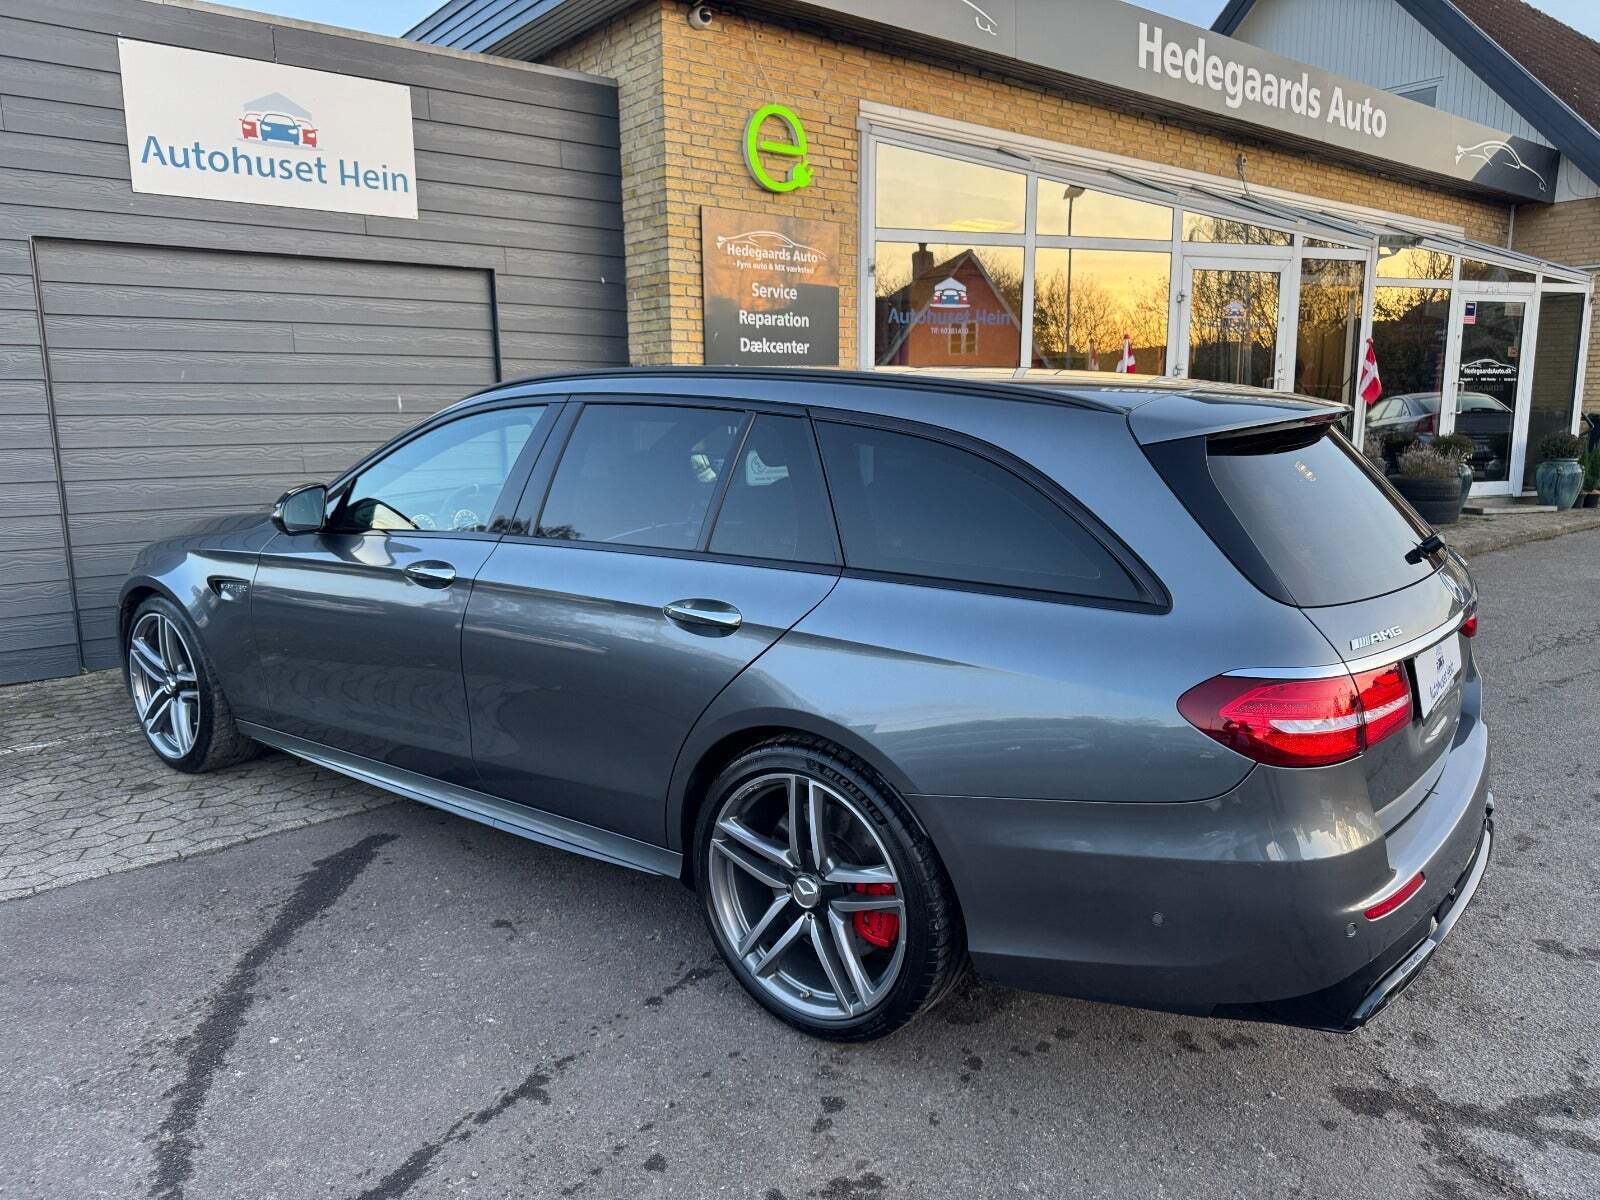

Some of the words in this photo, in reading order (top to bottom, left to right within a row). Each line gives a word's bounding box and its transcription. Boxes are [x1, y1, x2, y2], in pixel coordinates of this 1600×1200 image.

[1138, 22, 1321, 119] Hedegaards
[1327, 86, 1387, 139] Auto
[141, 135, 328, 184] Autohuset
[339, 159, 409, 193] Hein
[727, 243, 791, 261] Hedegaards
[793, 250, 818, 263] Auto
[751, 282, 798, 300] Service
[739, 309, 810, 328] Reparation
[887, 307, 971, 324] Autohuset
[975, 308, 1010, 325] Hein
[739, 337, 810, 354] Dækcenter
[1371, 625, 1403, 645] AMG
